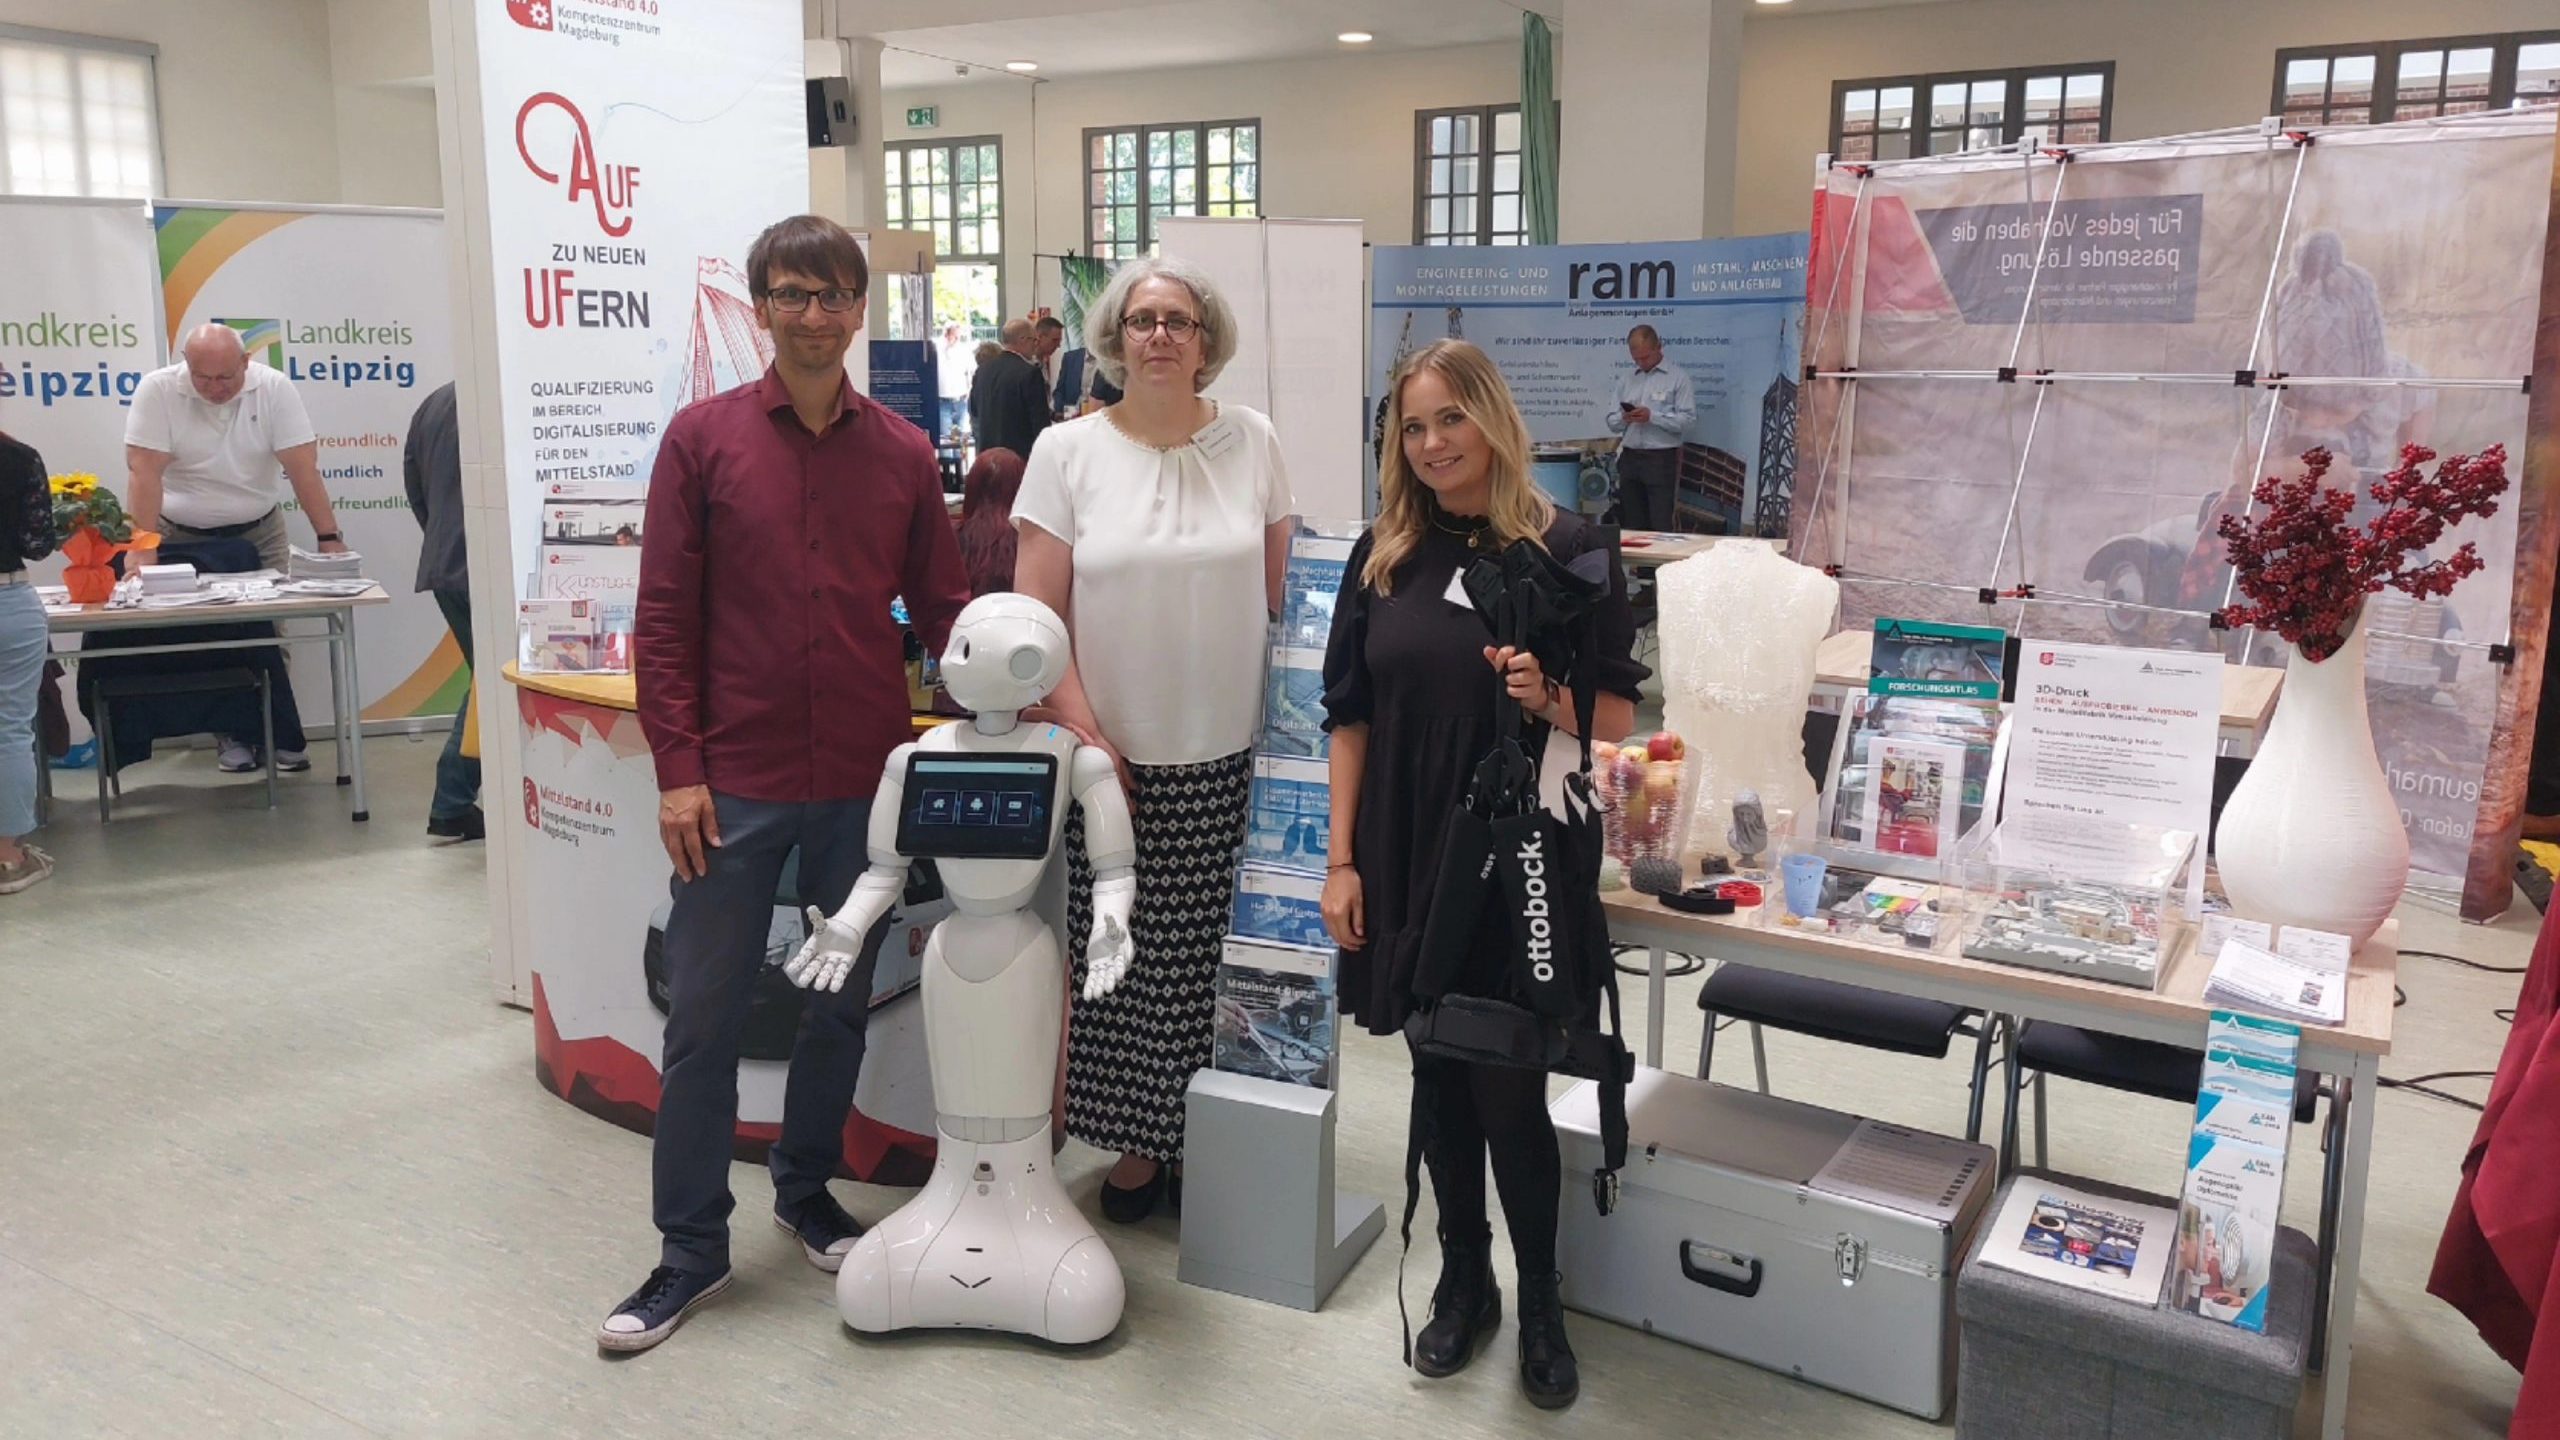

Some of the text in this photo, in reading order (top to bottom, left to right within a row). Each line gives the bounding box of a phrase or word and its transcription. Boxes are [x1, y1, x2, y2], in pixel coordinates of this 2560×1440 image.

[639, 0, 658, 16] 4.0
[557, 5, 661, 36] Kompetenzzentrum
[558, 22, 621, 47] Magdeburg
[552, 243, 646, 266] ZU NEUEN
[1518, 266, 1549, 280] UND
[1567, 259, 1676, 300] ram
[1395, 283, 1549, 297] MONTAGELEISTUNGEN
[1691, 277, 1783, 293] UND ANLAGENBAU
[523, 267, 650, 329] UFERN
[286, 318, 414, 346] Landkreis
[288, 355, 416, 388] Leipzig
[530, 380, 654, 397] QUALIFIZIERUNG
[532, 403, 602, 417] IM BEREICH
[533, 421, 657, 440] DIGITALISIERUNG
[535, 447, 588, 462] FÜR DEN
[535, 463, 635, 483] MITTELSTAND
[1888, 681, 1979, 695] FORSCHUNGSATLAS
[2035, 684, 2090, 699] 3D-Druck
[594, 800, 613, 818] 4.0
[1517, 830, 1554, 982] ottobock.
